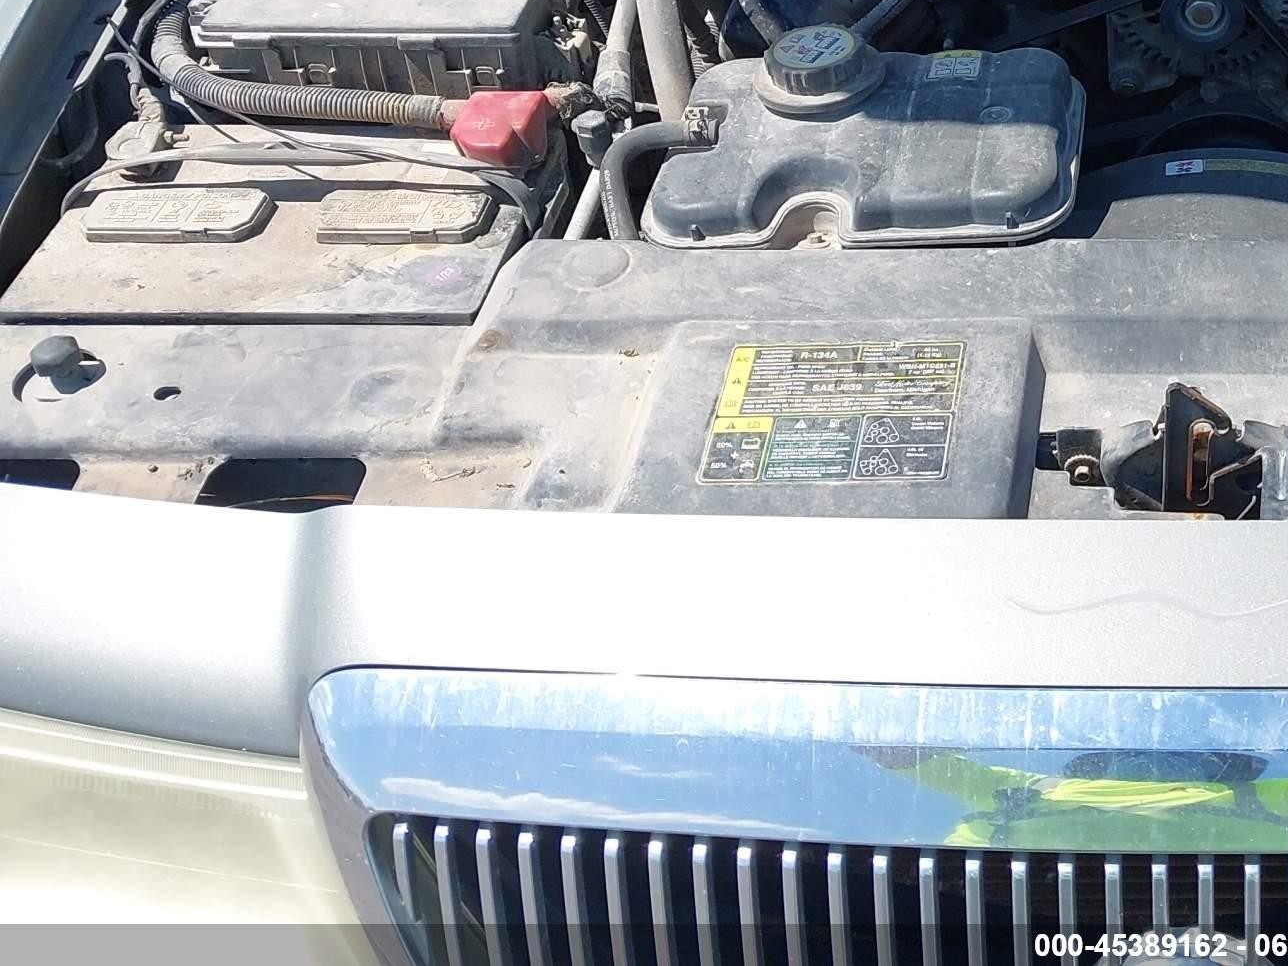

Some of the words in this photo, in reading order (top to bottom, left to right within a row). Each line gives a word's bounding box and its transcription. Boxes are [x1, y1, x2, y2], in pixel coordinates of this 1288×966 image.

[799, 351, 838, 360] R-134A
[811, 383, 836, 392] SAE
[837, 382, 863, 391] J639
